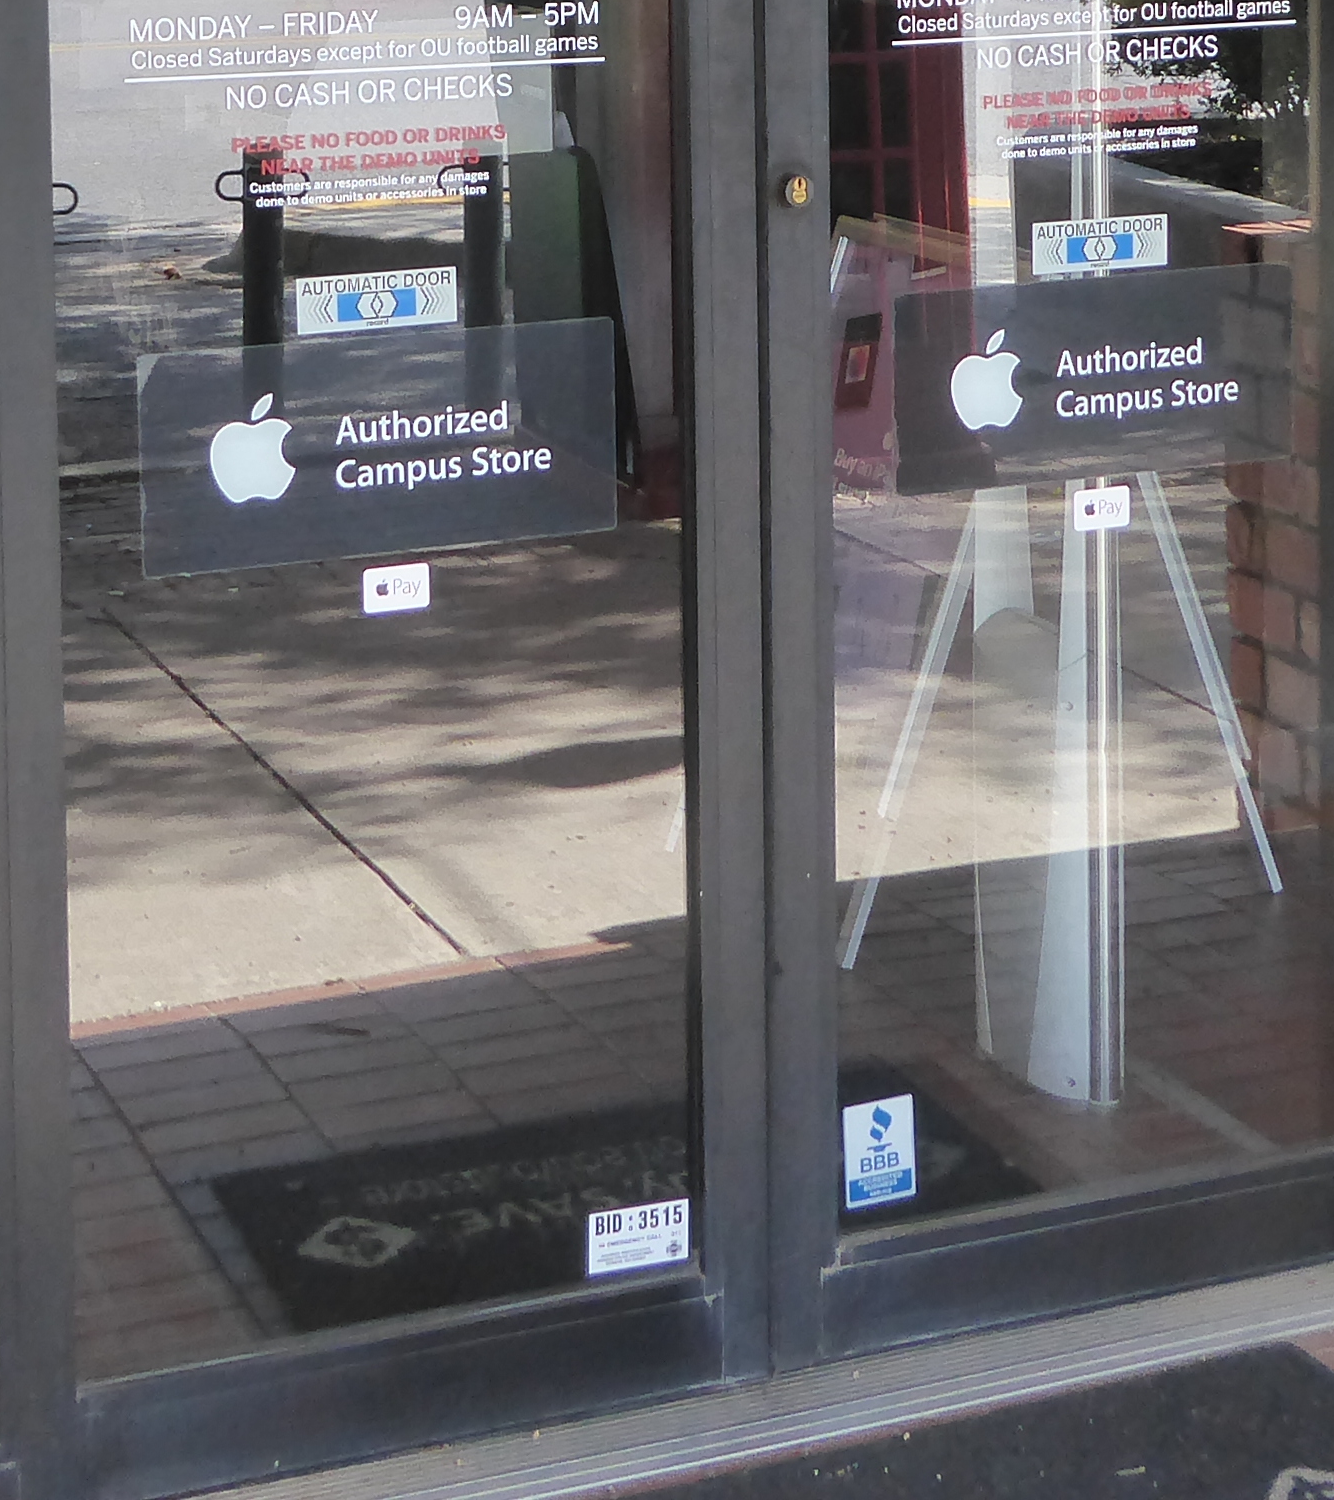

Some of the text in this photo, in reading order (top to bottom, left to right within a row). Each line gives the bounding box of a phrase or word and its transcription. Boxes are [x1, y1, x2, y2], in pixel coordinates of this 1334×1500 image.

[130, 1, 599, 42] MONDAY FRIDAY 9AM 5PM
[898, 13, 958, 34] Closed
[962, 10, 1049, 31] Saturdays
[1113, 4, 1137, 22] for
[1141, 2, 1167, 20] OU
[1236, 0, 1290, 20] games
[131, 34, 599, 69] Closed Saturdays except for OU football games
[977, 34, 1218, 70] NO CASH OR CHECKS
[225, 72, 514, 111] NO CASH OR CHECKS
[983, 91, 1044, 109] PLEASE
[1056, 111, 1088, 125] THE
[231, 124, 506, 154] PLEASE NO FOOD OR DRINKS
[997, 135, 1048, 146] Customers
[1050, 134, 1065, 143] are
[1122, 128, 1136, 137] for
[1138, 128, 1155, 139] any
[1156, 125, 1198, 136] damages
[1002, 148, 1025, 158] done
[1028, 148, 1038, 156] to
[1039, 145, 1067, 155] demo
[1068, 144, 1092, 154] units
[1106, 140, 1159, 151] accessories
[1161, 138, 1170, 148] in
[1172, 138, 1196, 147] store
[261, 148, 480, 176] NEAR THE DEMO UNITS
[249, 170, 490, 194] Customers are responsible for any damages
[255, 183, 487, 209] done to demo units or accessories in store
[1037, 218, 1163, 240] AUTOMATIC DOOR
[301, 270, 451, 297] AUTOMATIC DOOR
[1056, 337, 1203, 376] Authorized
[1056, 378, 1240, 419] Campus Store
[335, 400, 509, 445] Authorized
[335, 446, 553, 491] Campus Store
[1098, 499, 1122, 517] Pay
[392, 576, 422, 598] Pay
[860, 1151, 900, 1173] BBB
[595, 1213, 622, 1236] BID
[638, 1204, 682, 1230] 3515
